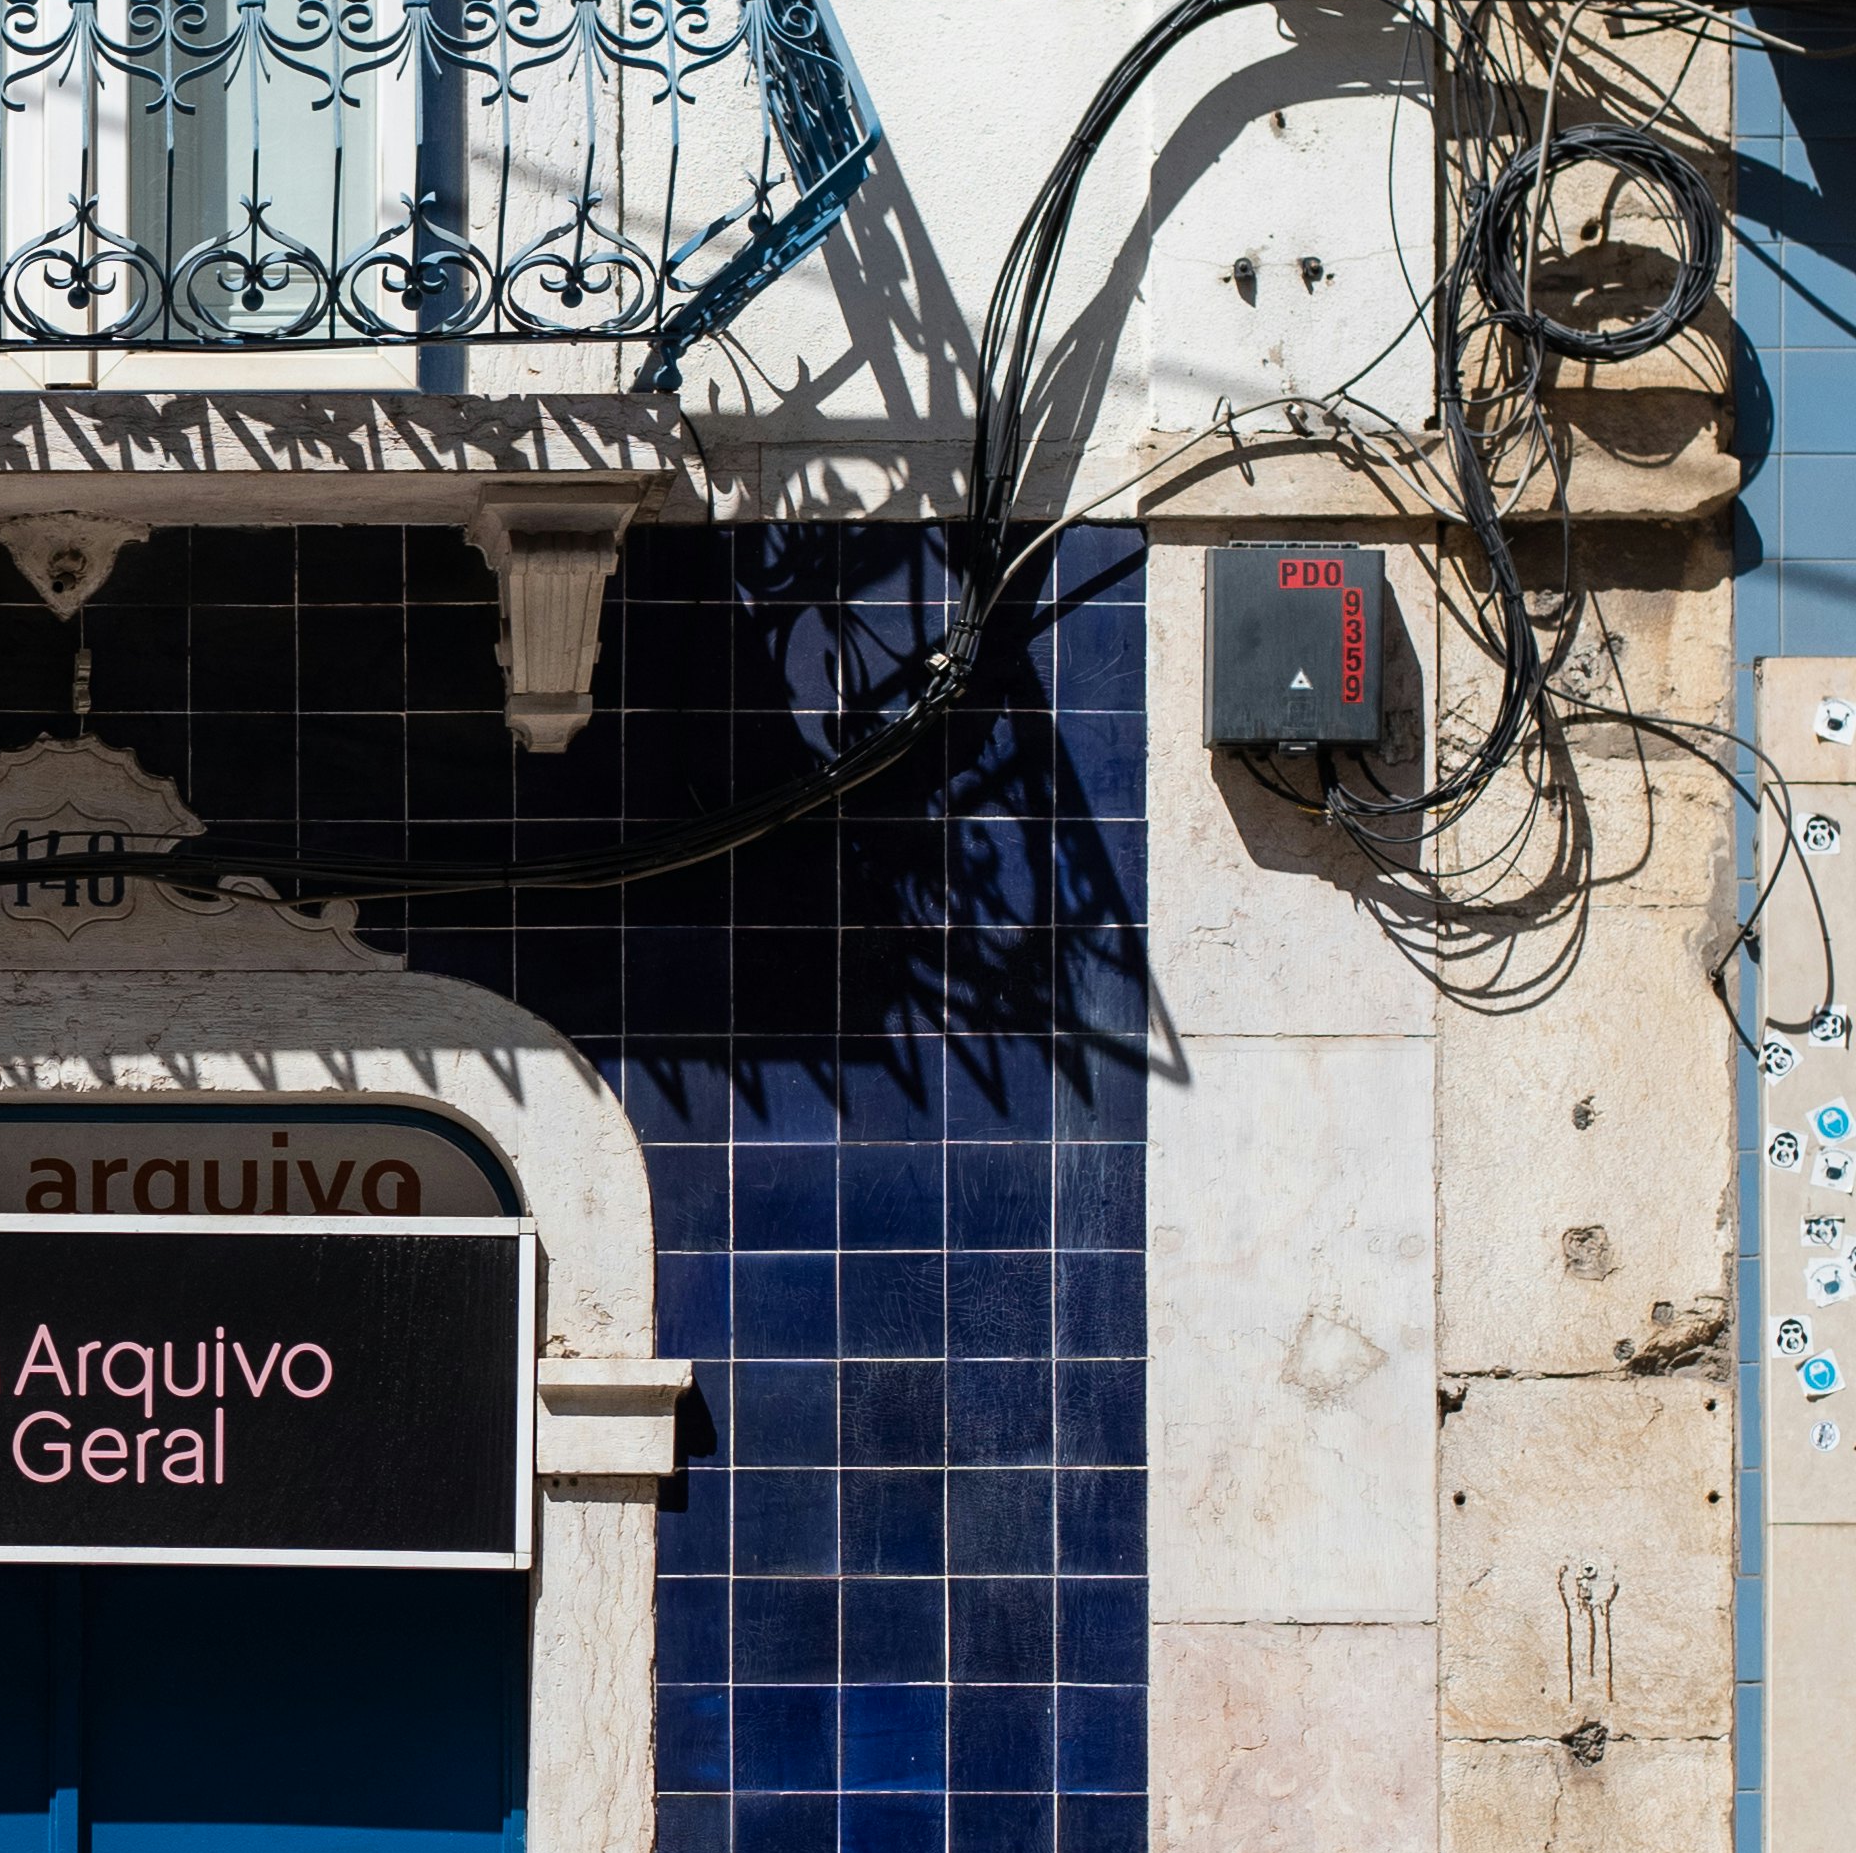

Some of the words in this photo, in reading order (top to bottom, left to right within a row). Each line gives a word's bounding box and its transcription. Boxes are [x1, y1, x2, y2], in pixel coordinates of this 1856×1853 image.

[1344, 590, 1363, 702] 9359
[13, 829, 126, 907] 140
[11, 1322, 334, 1418] Arquivo
[10, 1406, 226, 1485] Geral
